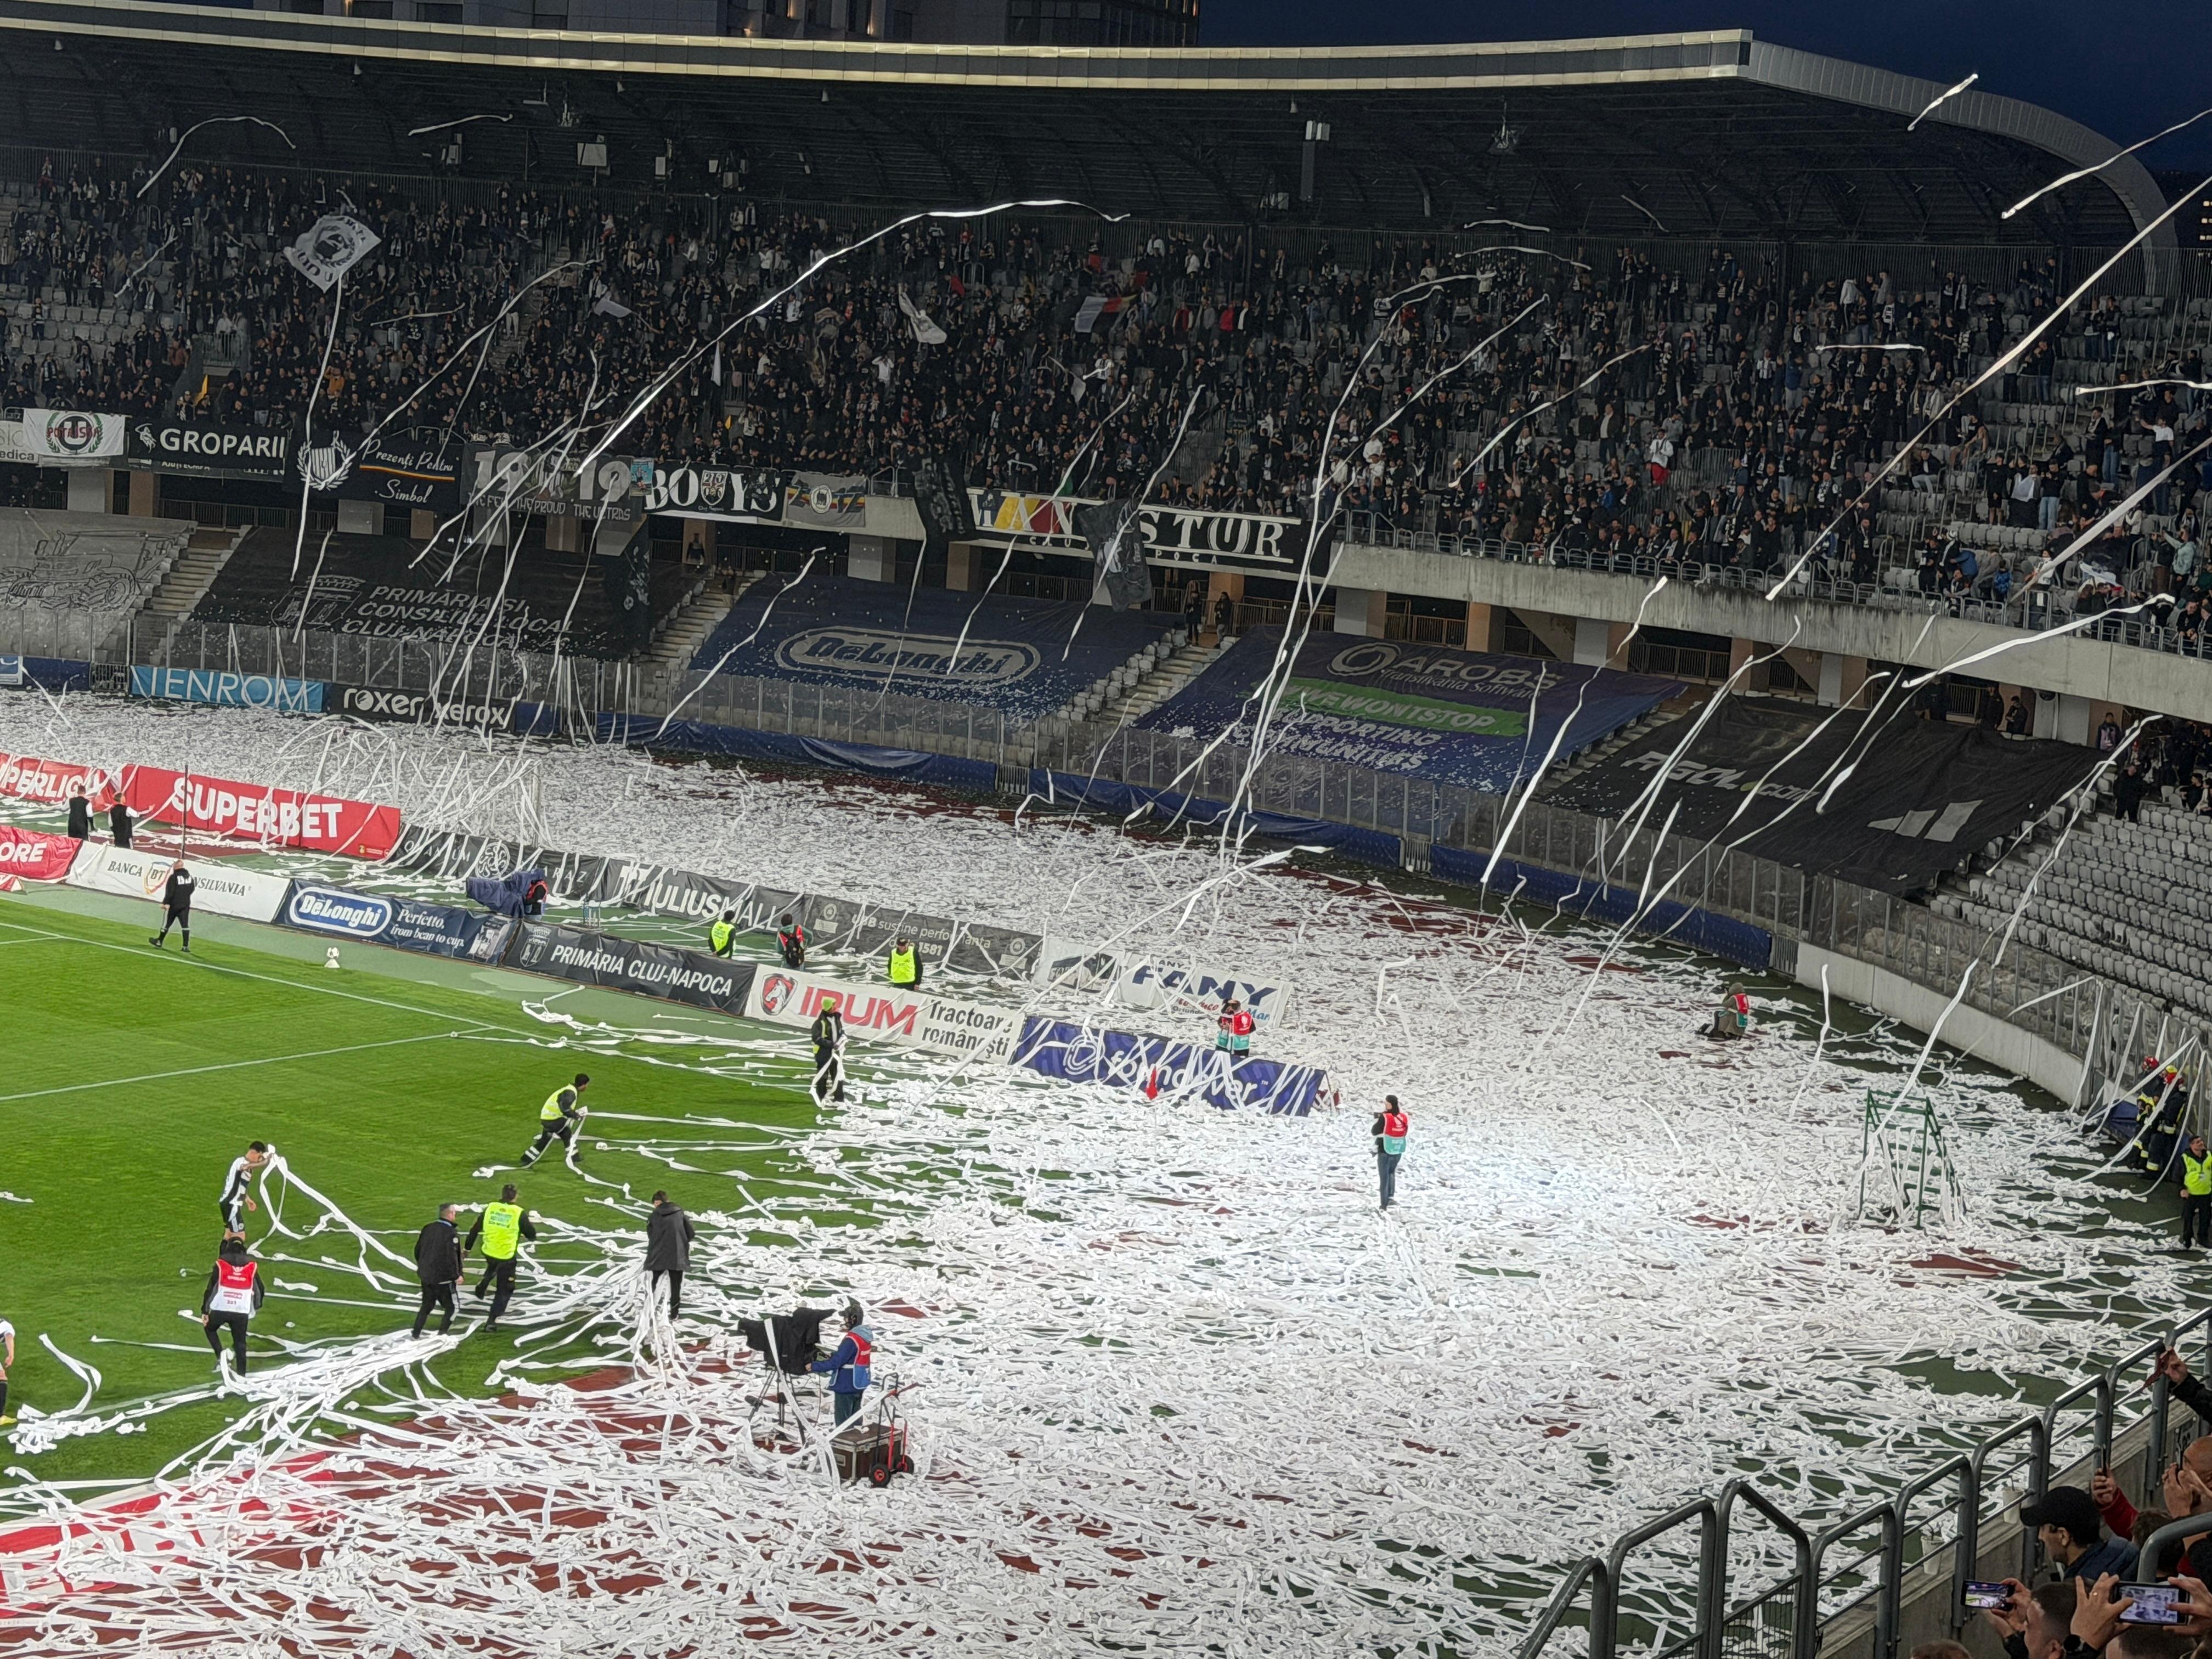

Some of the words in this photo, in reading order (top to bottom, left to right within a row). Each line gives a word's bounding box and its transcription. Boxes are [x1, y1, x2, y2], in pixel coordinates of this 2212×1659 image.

[160, 428, 285, 458] GROPARII
[379, 479, 433, 504] Simbol
[534, 500, 566, 515] PROUD
[574, 503, 591, 518] THE
[592, 506, 631, 521] UTRAS
[1391, 654, 1564, 691] AROBS
[171, 777, 343, 839] SUPERBET
[108, 860, 143, 877] BANCA
[150, 868, 166, 881] BT
[396, 909, 445, 929] Perfetto,
[389, 923, 413, 936] from
[414, 929, 436, 941] bean
[436, 932, 444, 943] to
[918, 941, 943, 957] 1581
[550, 945, 624, 975] PRIMĂRIA
[627, 960, 733, 997] CLUJ-NAPOCA
[1132, 964, 1279, 1007] FANY
